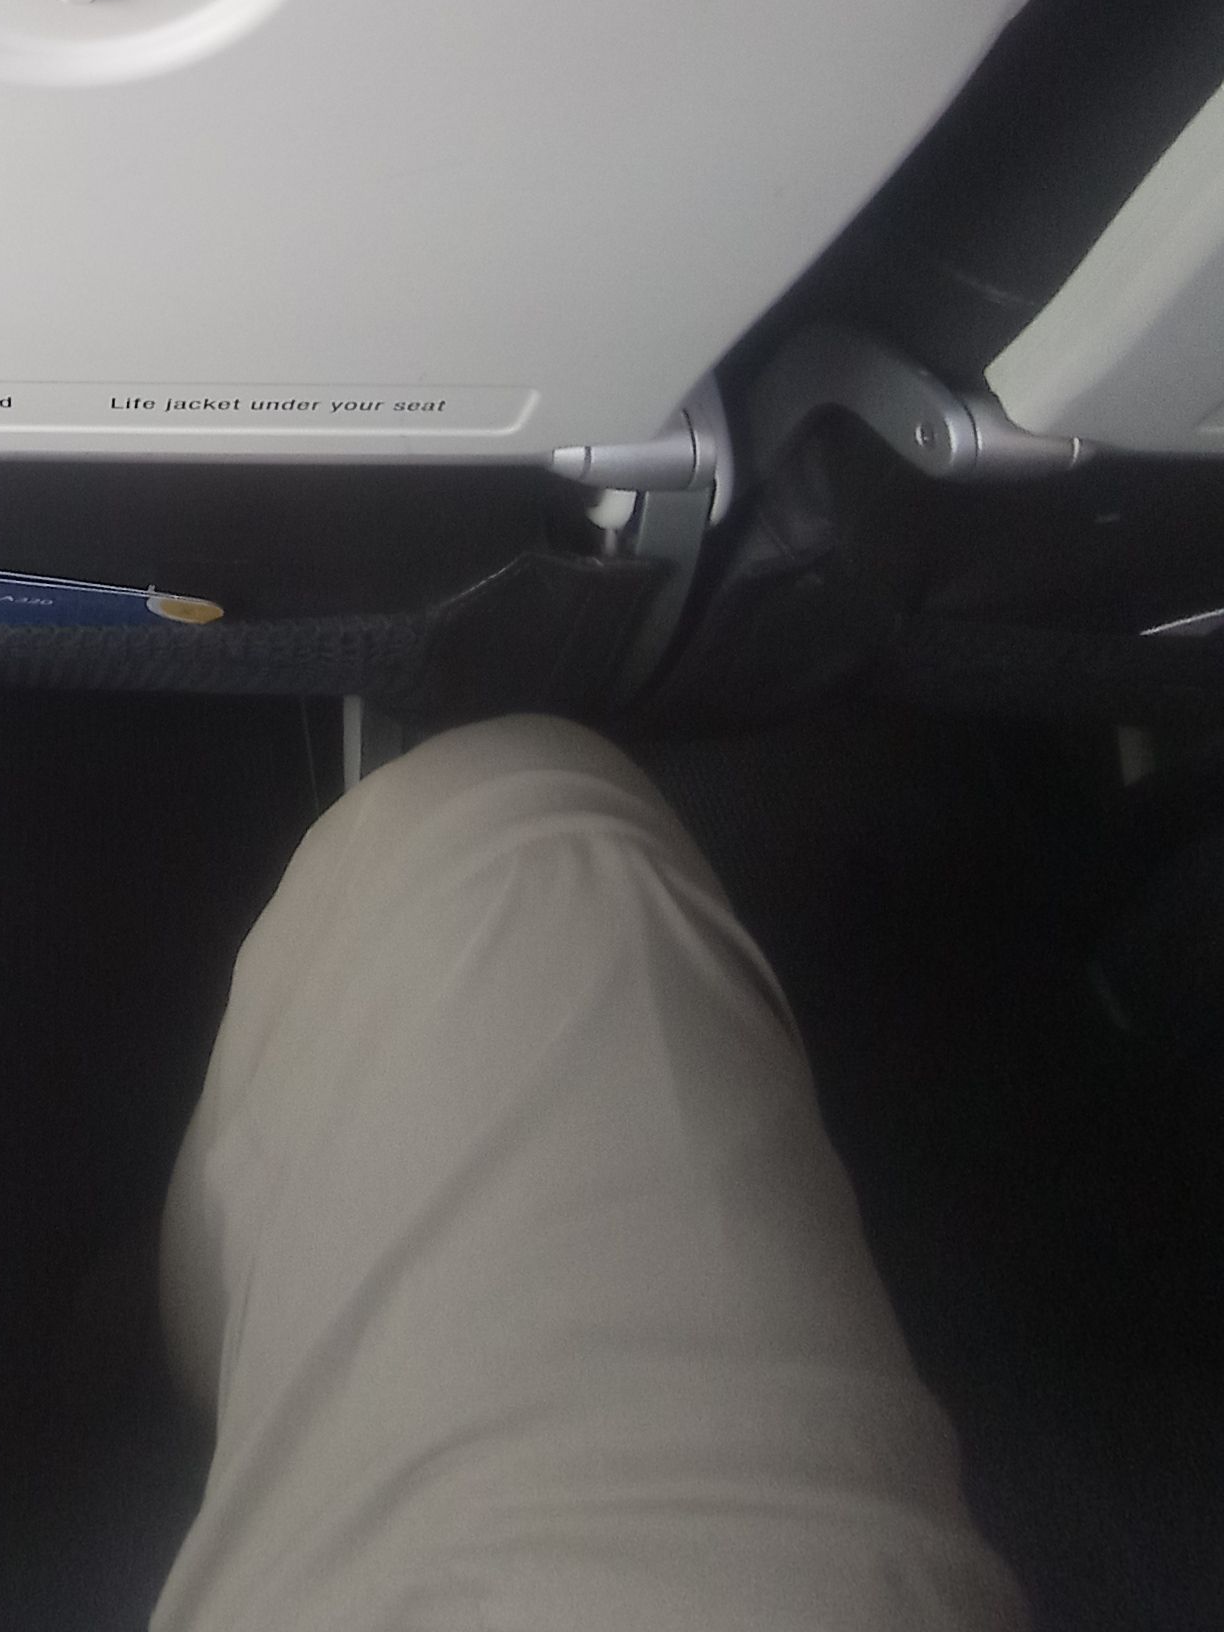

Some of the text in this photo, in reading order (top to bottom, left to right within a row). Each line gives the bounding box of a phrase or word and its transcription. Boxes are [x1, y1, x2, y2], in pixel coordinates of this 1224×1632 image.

[110, 397, 447, 414] Life jacket under your seat
